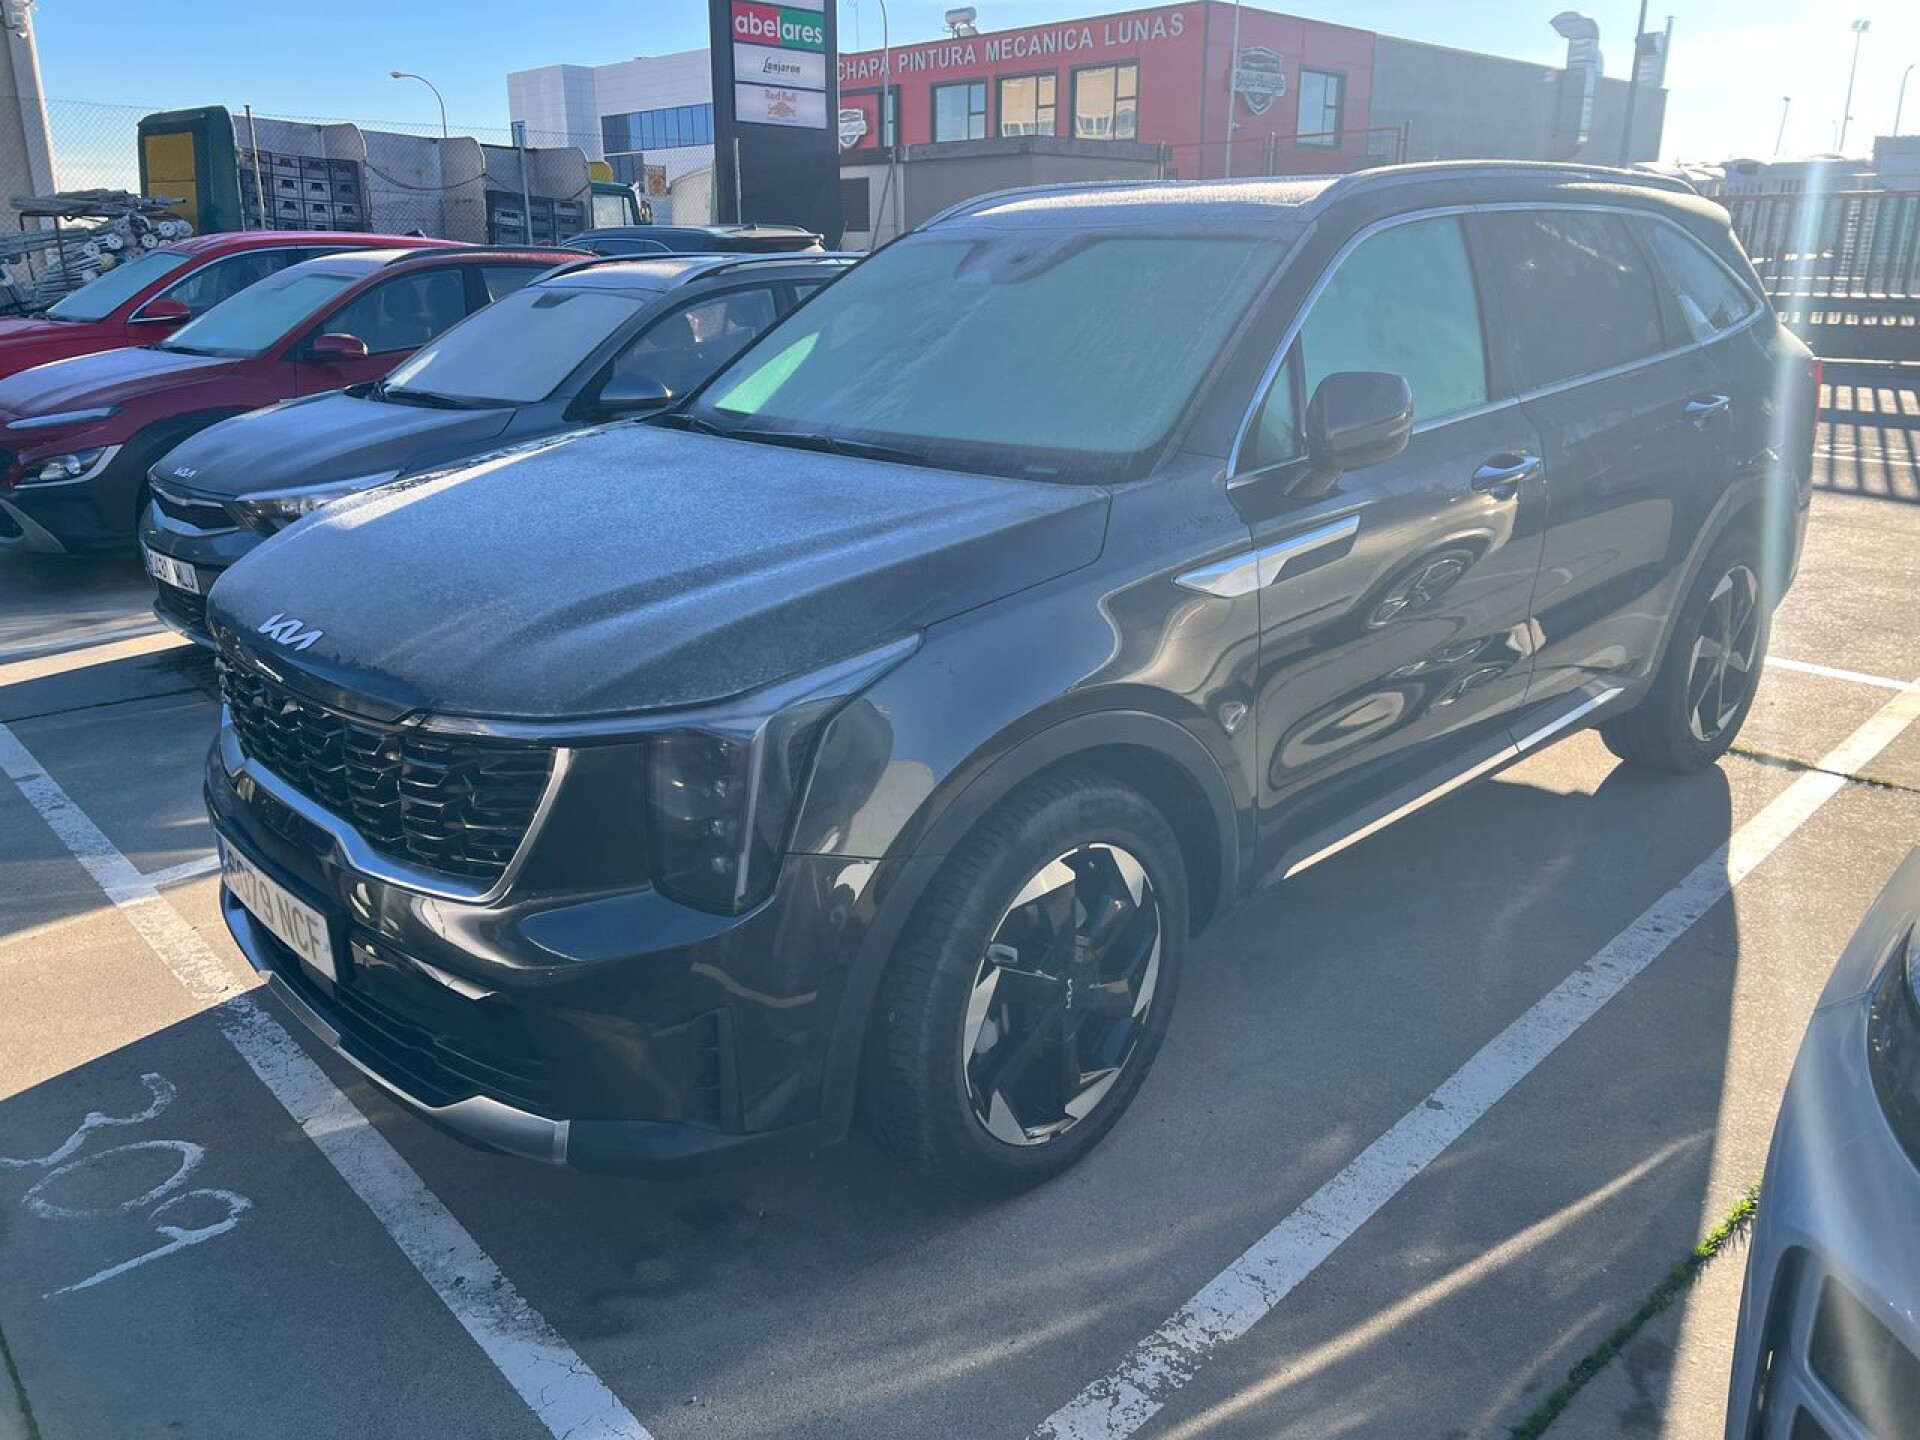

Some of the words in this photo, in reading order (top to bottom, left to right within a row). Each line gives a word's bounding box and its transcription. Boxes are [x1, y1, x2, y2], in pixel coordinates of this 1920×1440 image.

[734, 11, 823, 44] abelares
[838, 56, 891, 82] CHAPA
[898, 44, 976, 73] PINTURA
[986, 27, 1093, 62] MECANICA
[1104, 12, 1184, 46] LUNAS
[277, 893, 320, 961] NCF
